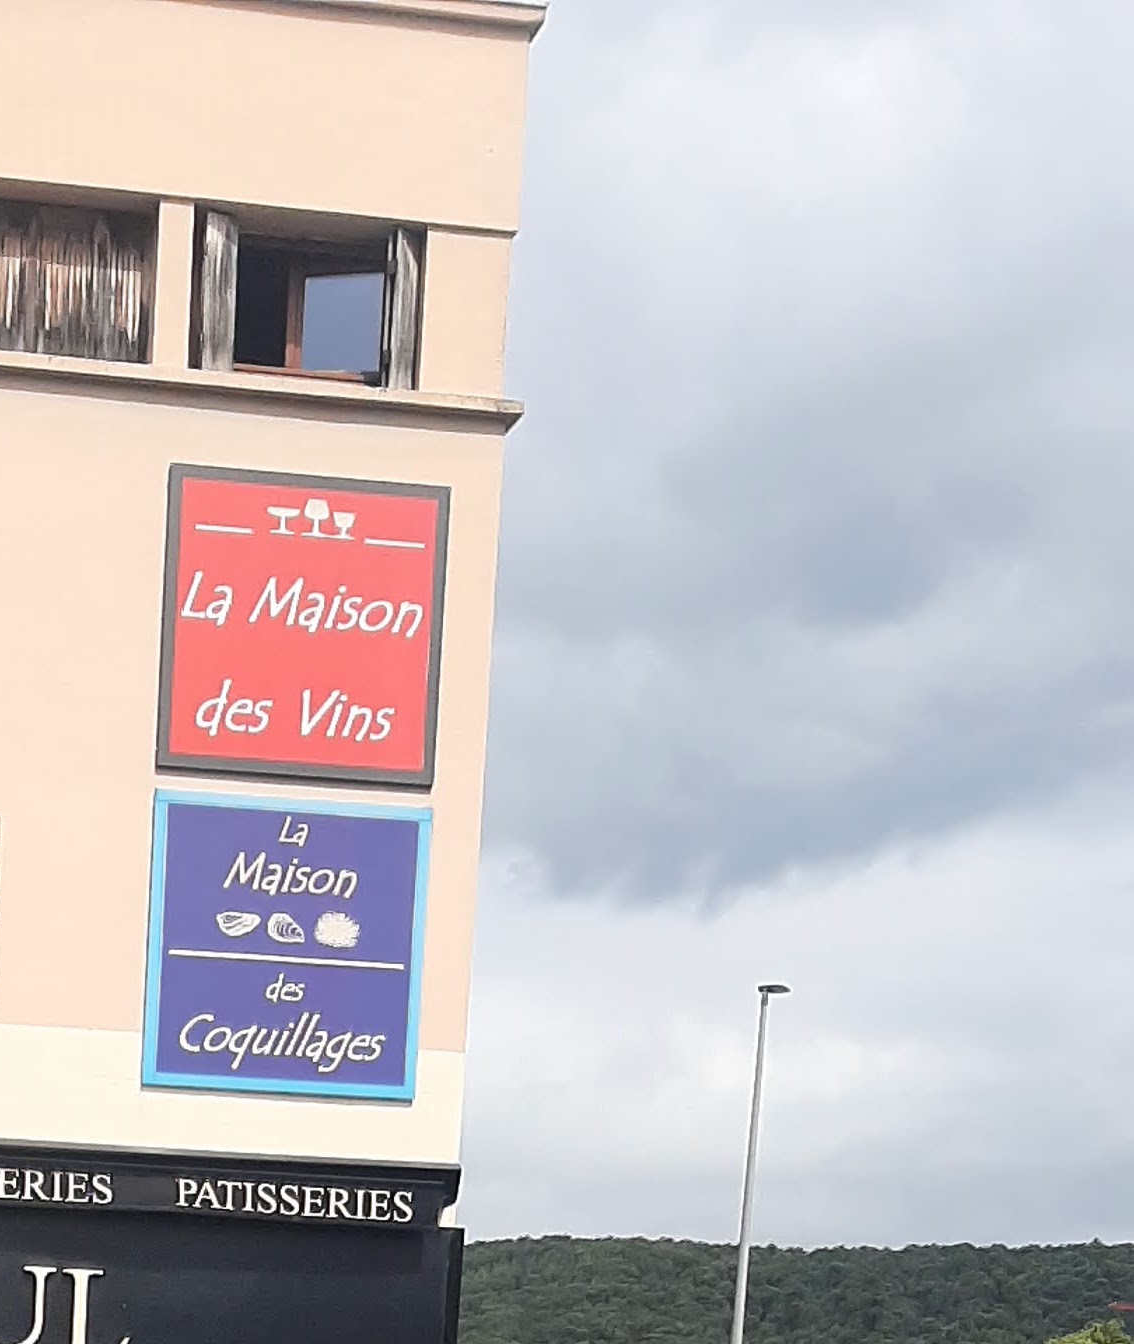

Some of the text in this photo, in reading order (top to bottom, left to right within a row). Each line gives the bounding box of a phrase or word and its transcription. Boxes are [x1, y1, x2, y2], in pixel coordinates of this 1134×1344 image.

[181, 570, 424, 639] La Maison
[195, 677, 396, 742] des Vins
[277, 815, 310, 848] La
[222, 850, 358, 899] Maison
[265, 972, 306, 1003] des
[178, 1011, 387, 1074] Coquillages
[174, 1177, 414, 1223] PATISSERIES
